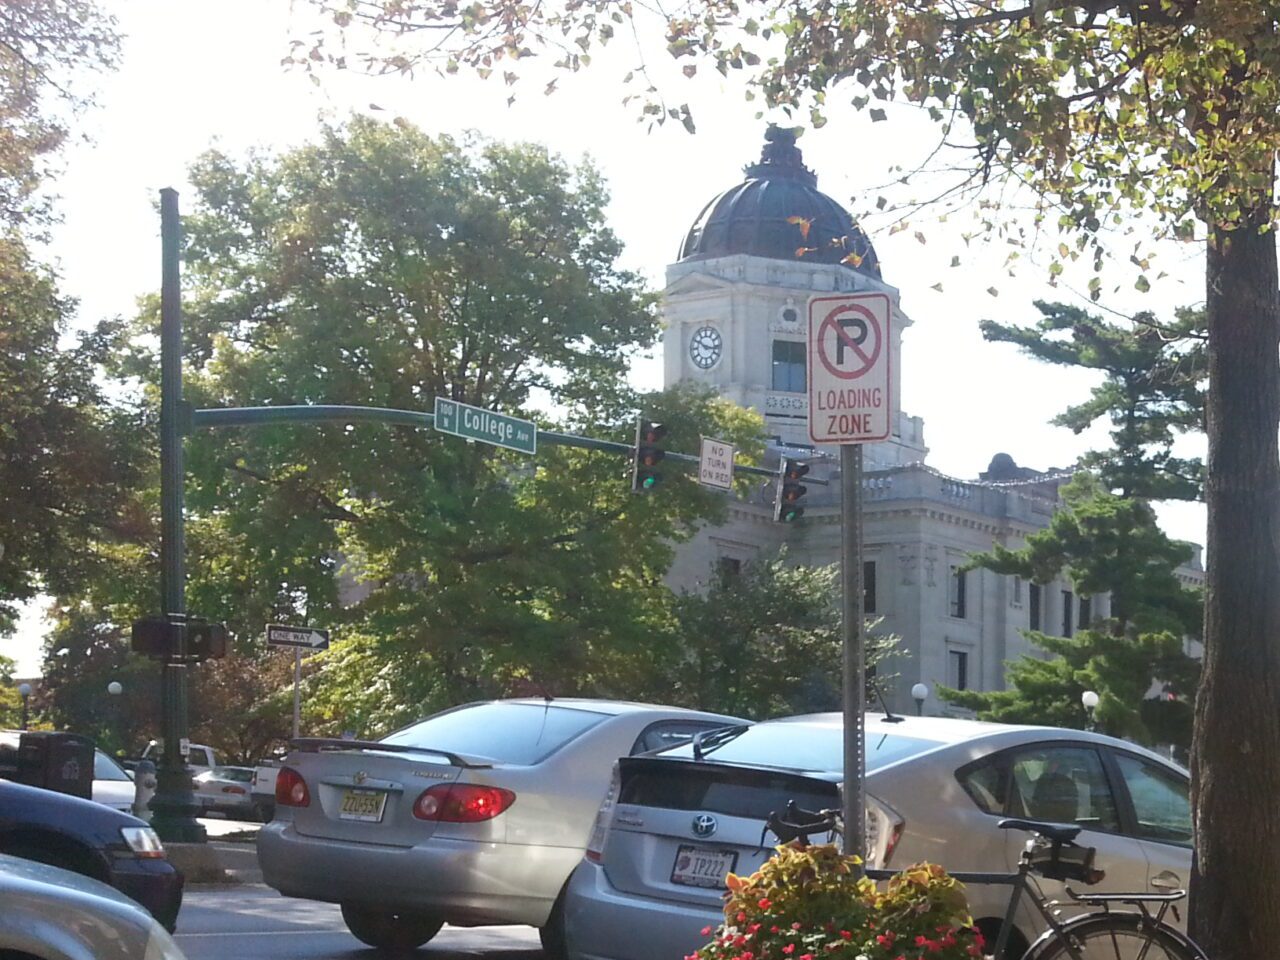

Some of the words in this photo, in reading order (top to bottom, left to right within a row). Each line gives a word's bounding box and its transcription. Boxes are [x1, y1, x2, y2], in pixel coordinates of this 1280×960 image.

[818, 387, 881, 410] LOADING
[440, 403, 453, 416] 100
[464, 408, 513, 442] College
[516, 430, 529, 441] Ave
[827, 413, 872, 435] ZONE
[712, 446, 724, 457] NO
[708, 457, 726, 470] TURN
[702, 469, 713, 479] ON
[293, 633, 310, 641] WAY
